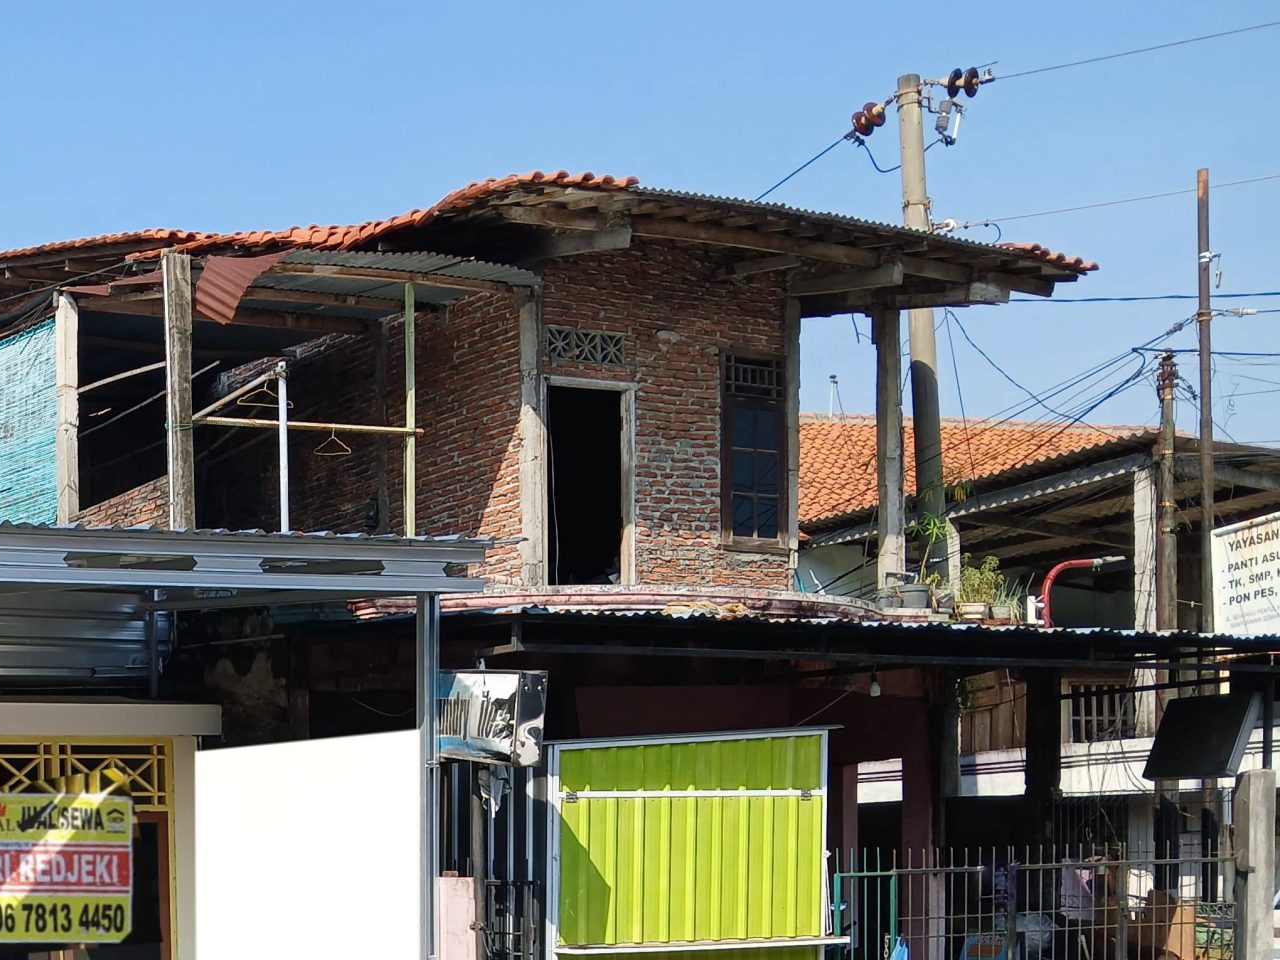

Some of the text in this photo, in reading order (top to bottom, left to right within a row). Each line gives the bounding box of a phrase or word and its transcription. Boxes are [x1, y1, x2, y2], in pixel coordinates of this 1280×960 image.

[1228, 528, 1280, 553] YAYASAN
[1228, 557, 1258, 573] PANTI
[1248, 570, 1273, 585] SMP,
[1229, 586, 1278, 606] PON PES,
[19, 852, 119, 884] REDJEKI
[21, 902, 73, 933] 7813
[78, 902, 125, 934] 4450
